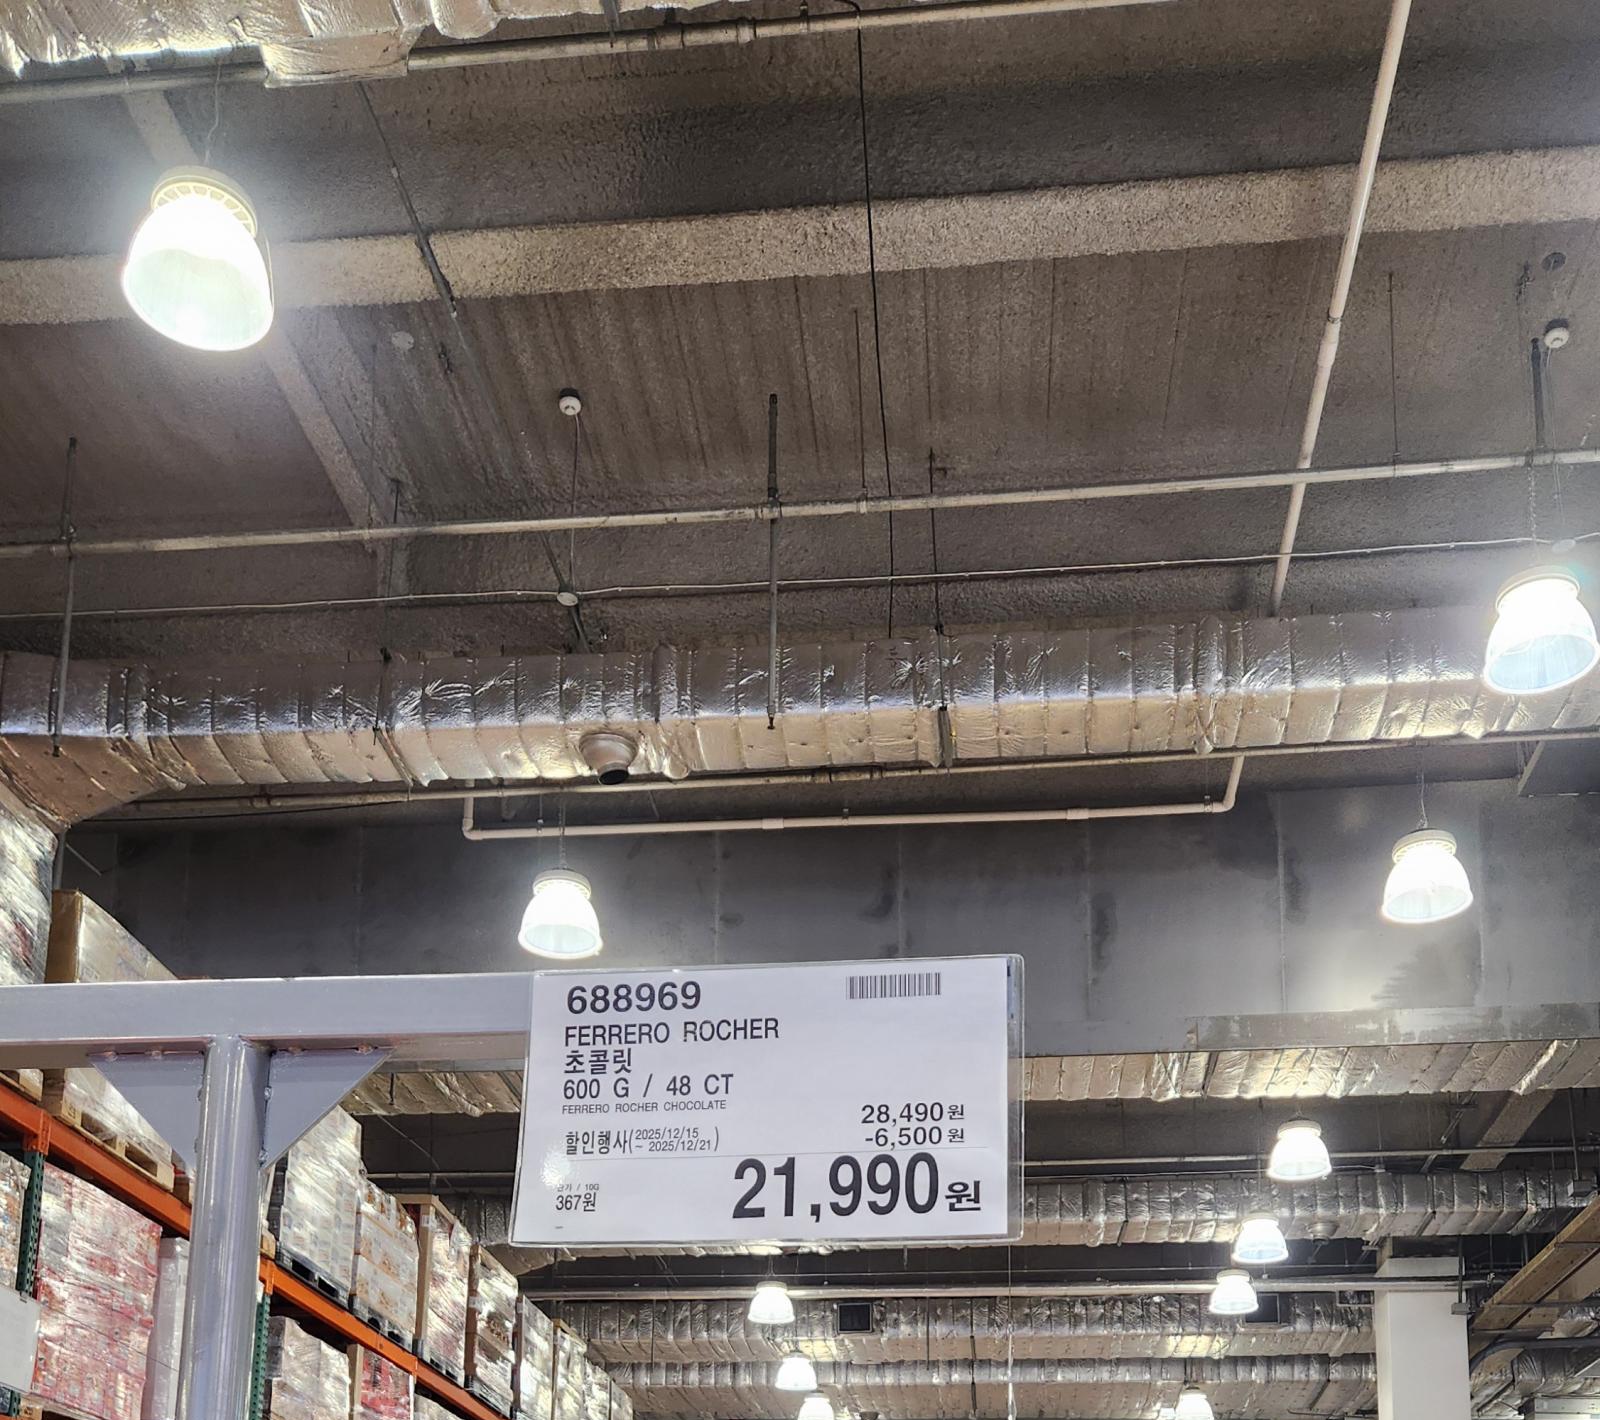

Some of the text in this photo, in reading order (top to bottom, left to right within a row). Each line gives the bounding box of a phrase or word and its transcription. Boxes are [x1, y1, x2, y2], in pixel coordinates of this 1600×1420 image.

[566, 981, 701, 1014] 688969
[564, 1018, 779, 1047] FERRERO ROCHER
[564, 1048, 632, 1075] 초콜릿
[563, 1073, 734, 1100] 600 G / 48 CT
[562, 1100, 727, 1114] FERRERO ROCHER CHOCOLATE
[556, 1192, 597, 1212] 367원
